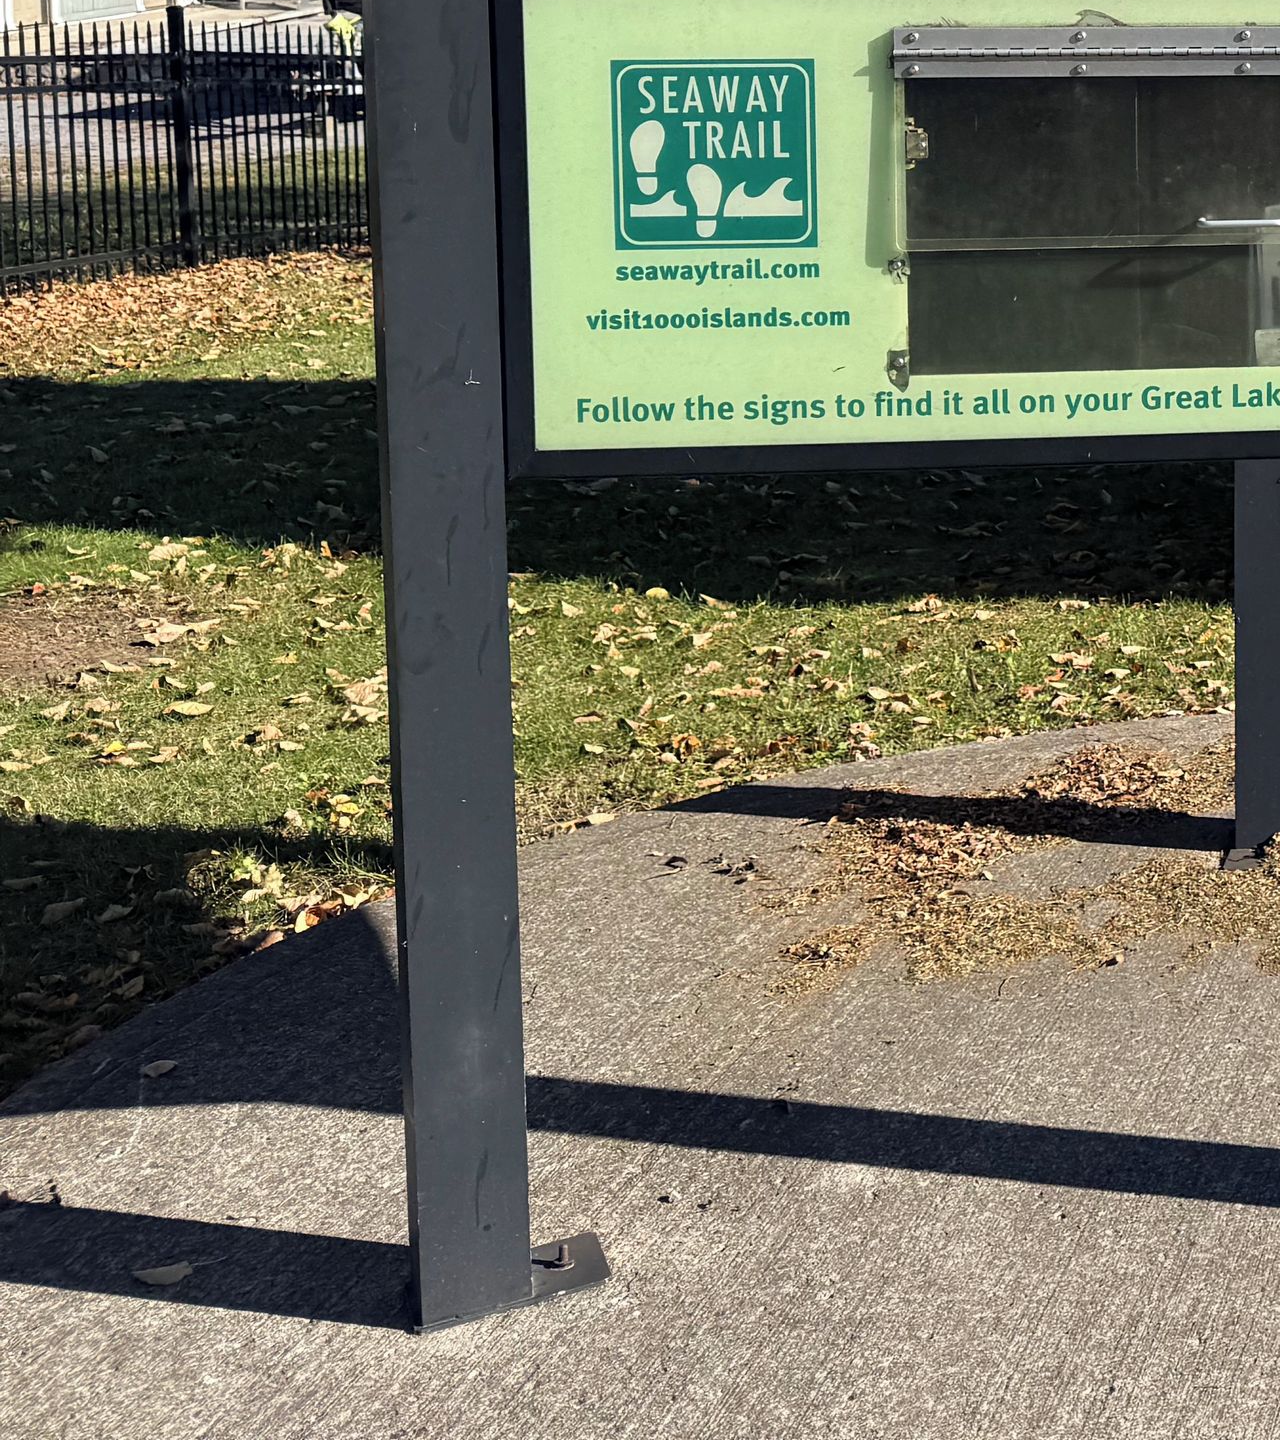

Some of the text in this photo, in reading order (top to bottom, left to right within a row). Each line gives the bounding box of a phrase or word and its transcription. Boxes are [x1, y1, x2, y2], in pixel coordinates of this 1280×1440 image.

[638, 75, 789, 114] SEAWAY
[682, 120, 790, 159] TRAIL
[615, 257, 820, 286] seawaytrail.com
[585, 306, 851, 331] visit1000islands.com
[577, 396, 676, 423] Follow
[683, 394, 735, 422] the
[743, 392, 826, 426] signs
[834, 394, 866, 418] to
[874, 390, 933, 417] find
[943, 389, 964, 416] it
[972, 388, 1011, 415] all
[1019, 394, 1055, 414] on
[1064, 392, 1133, 419] your
[1140, 385, 1223, 411] Great
